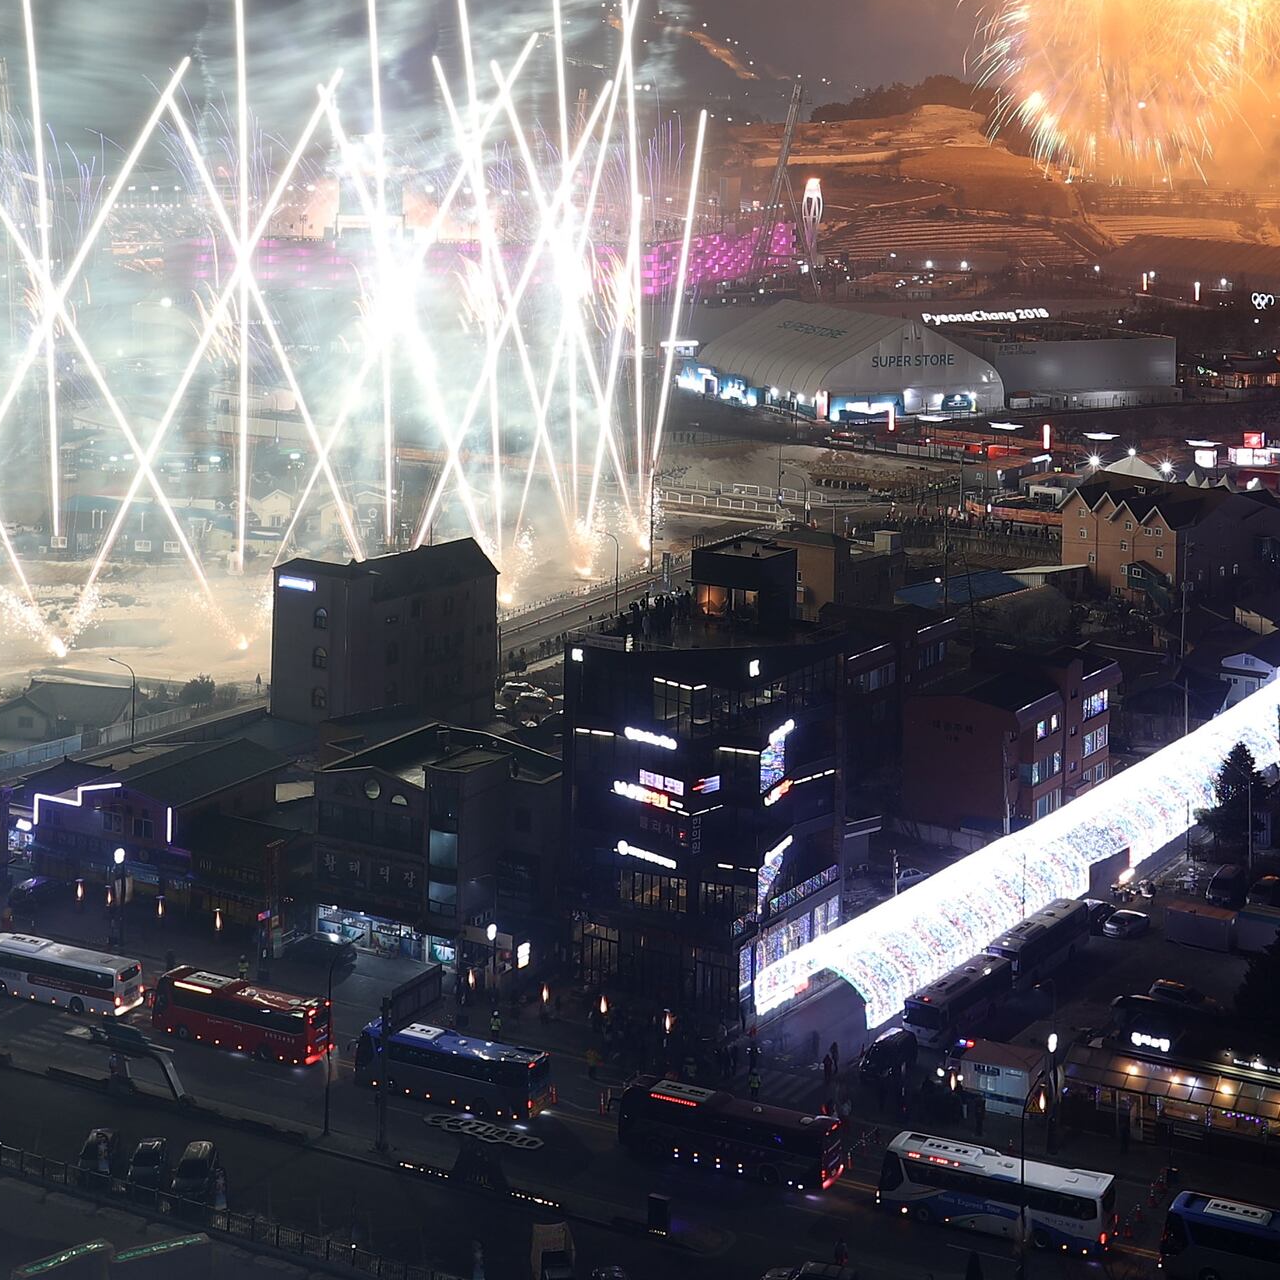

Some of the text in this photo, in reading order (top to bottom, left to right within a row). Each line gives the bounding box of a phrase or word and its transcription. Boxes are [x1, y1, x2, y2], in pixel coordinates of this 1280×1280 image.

[922, 308, 1050, 326] PyeongChang 2018
[872, 353, 955, 368] SUPER STORE
